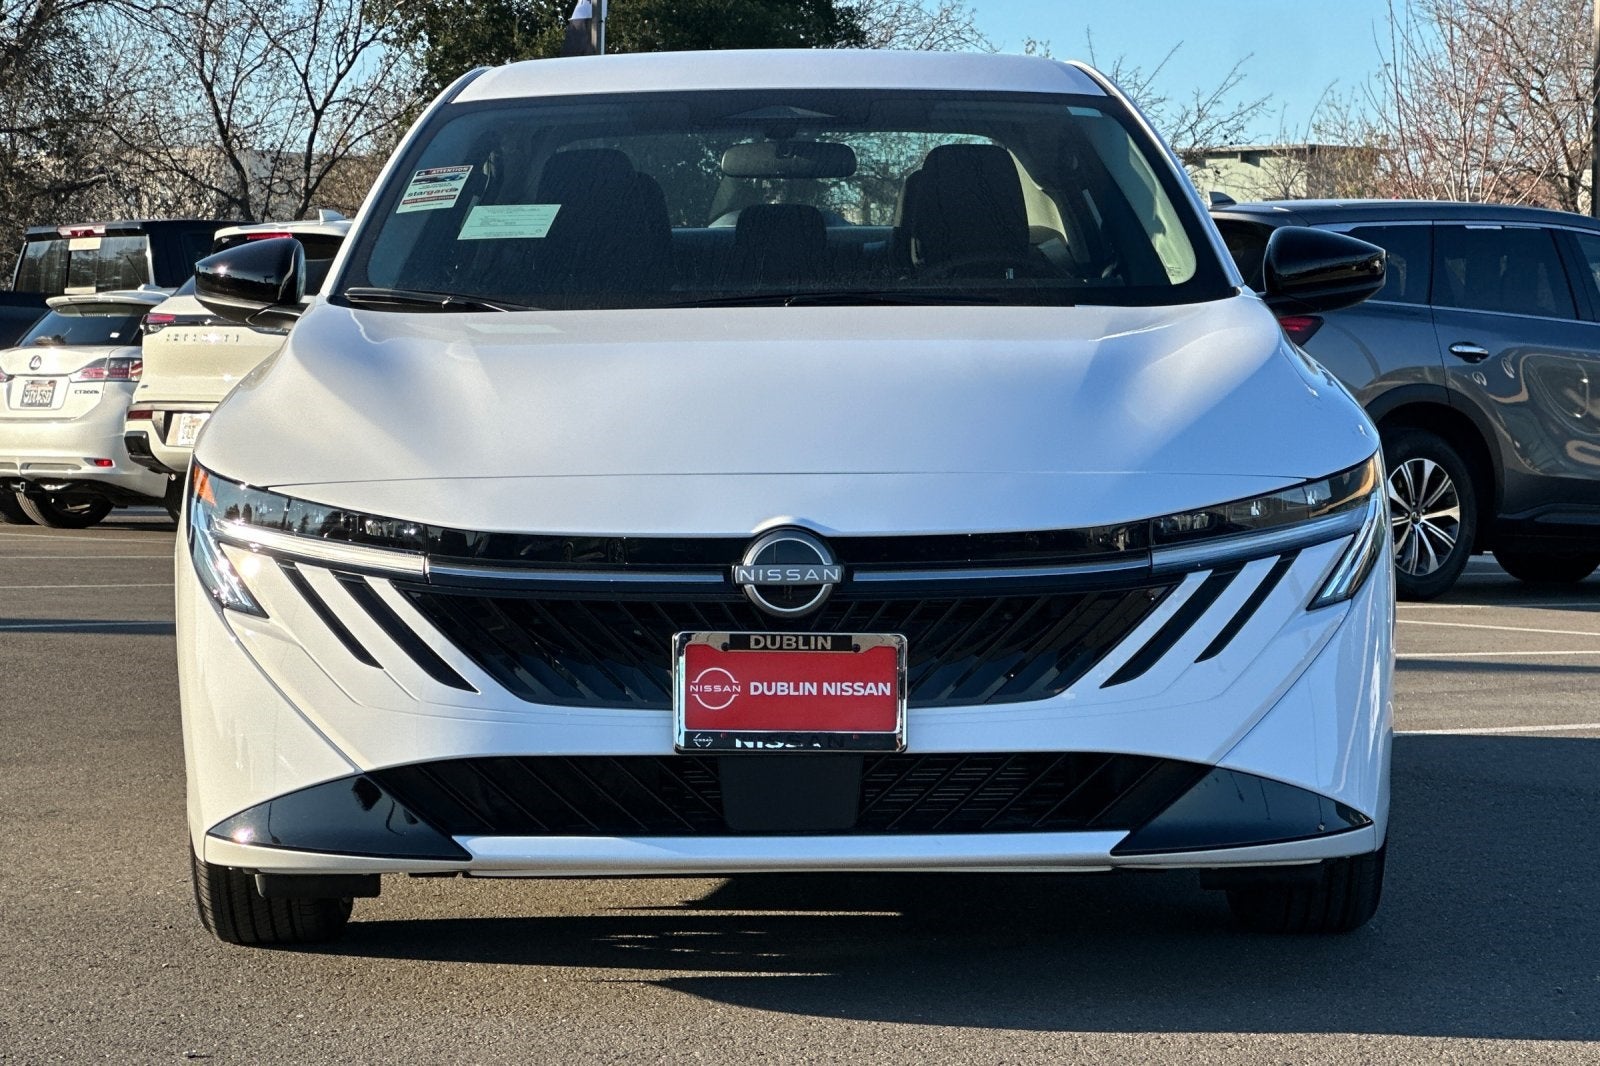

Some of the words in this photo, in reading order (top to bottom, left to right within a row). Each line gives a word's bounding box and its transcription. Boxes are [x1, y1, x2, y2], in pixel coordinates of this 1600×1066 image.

[740, 569, 838, 581] NISSAN
[750, 635, 832, 650] DUBLIN
[690, 684, 741, 693] NISSAN
[750, 682, 817, 696] DUBLIN
[823, 682, 891, 696] NISSAN
